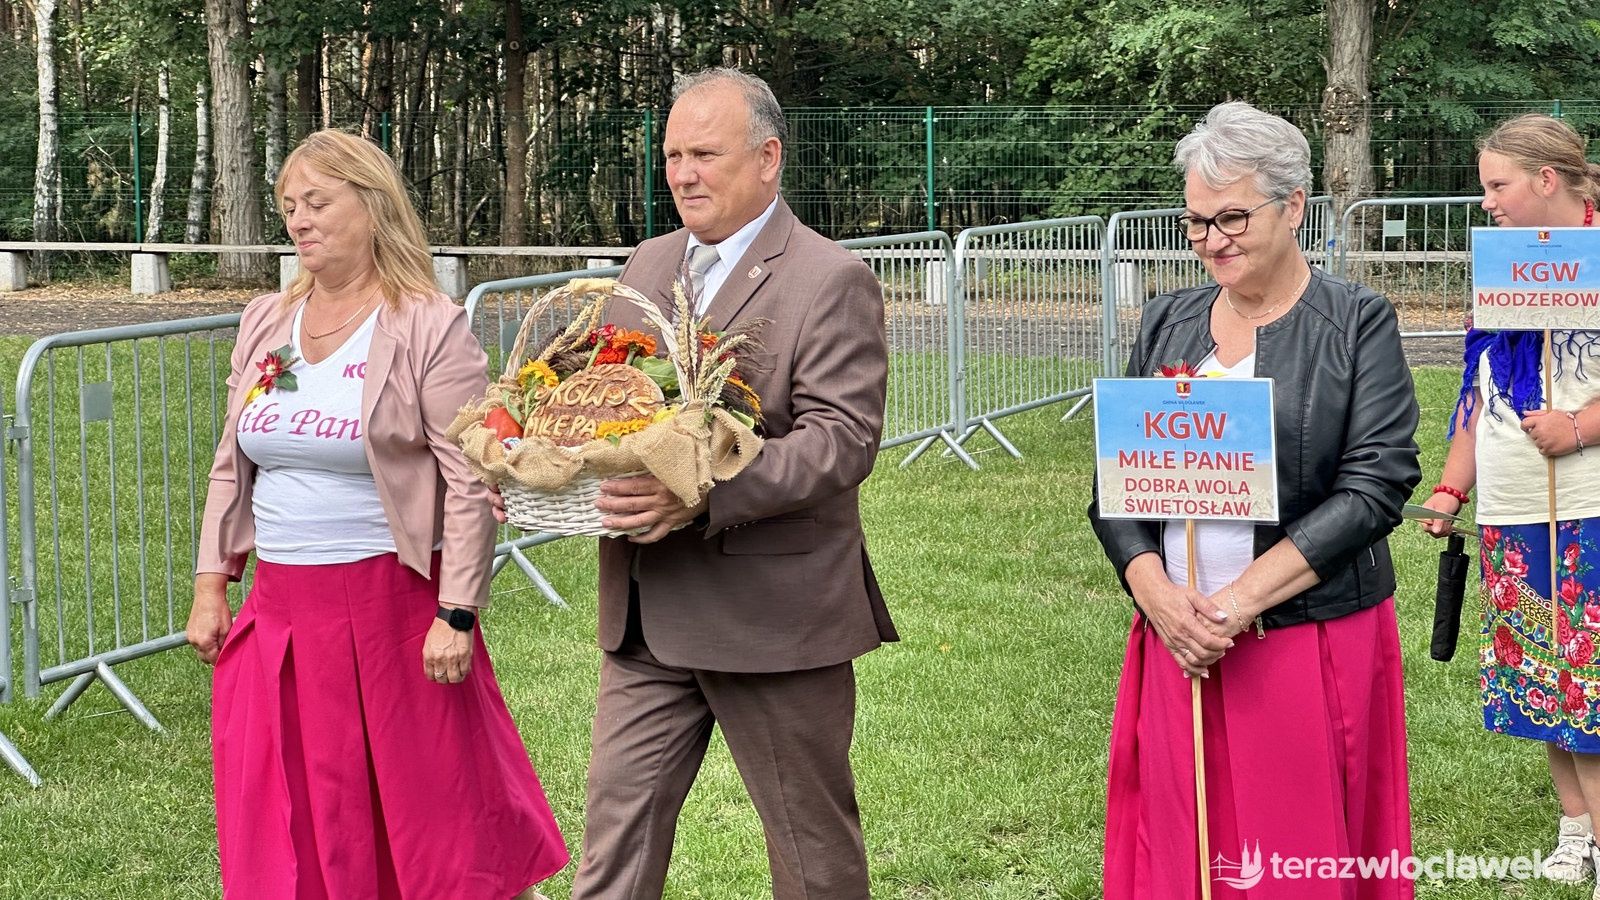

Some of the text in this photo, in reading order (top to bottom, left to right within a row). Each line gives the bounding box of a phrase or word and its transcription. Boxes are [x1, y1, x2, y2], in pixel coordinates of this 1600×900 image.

[1512, 262, 1580, 282] KGW
[1478, 292, 1599, 307] MODZEROW
[342, 361, 368, 379] KG
[546, 379, 611, 408] KGW
[288, 409, 363, 441] Pan
[1144, 411, 1227, 440] KGW
[1118, 449, 1255, 472] MIŁE PANIE
[1124, 477, 1251, 495] DOBRA WOLA
[1124, 495, 1251, 516] ŚWIĘTOSŁAW
